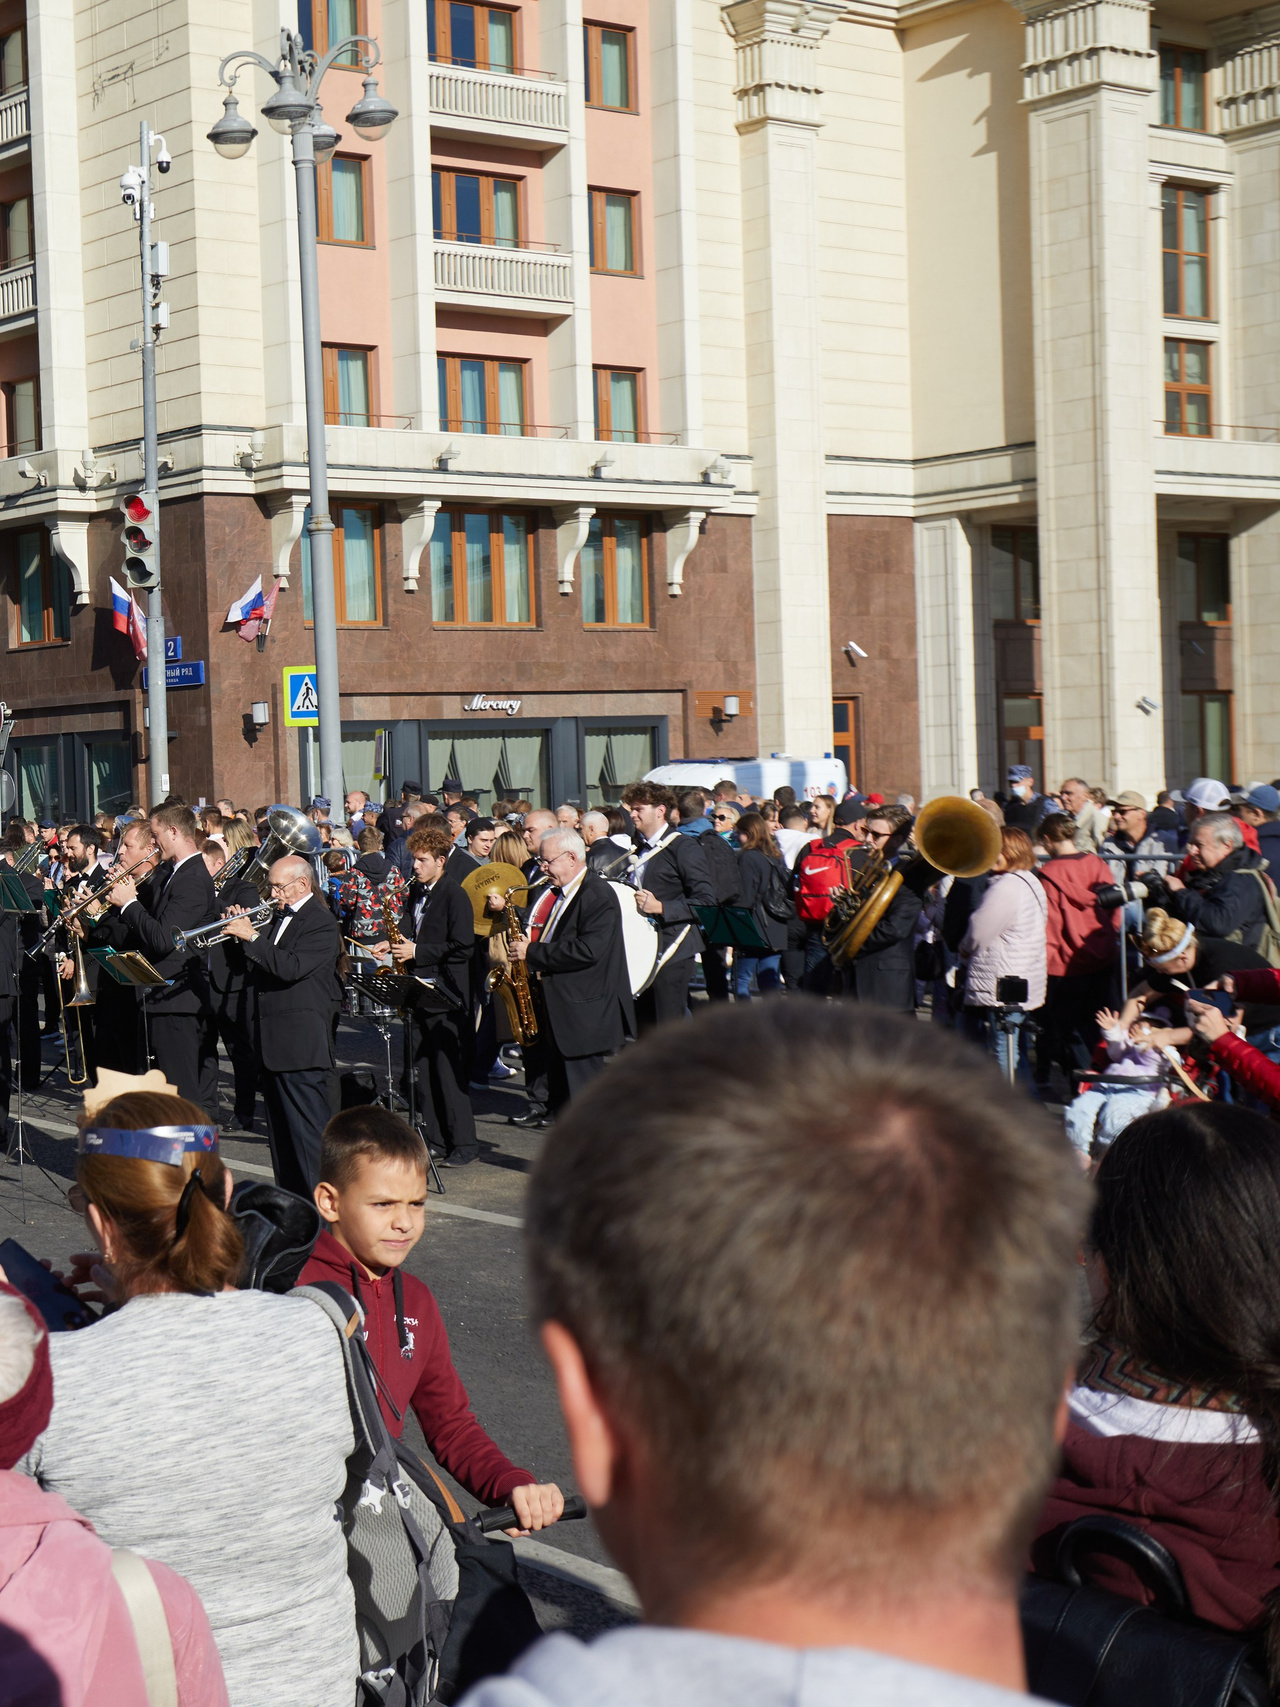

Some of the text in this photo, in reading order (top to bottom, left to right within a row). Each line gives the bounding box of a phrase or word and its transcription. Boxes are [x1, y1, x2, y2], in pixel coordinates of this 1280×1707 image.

[167, 641, 175, 656] 2
[181, 667, 193, 676] РЯД
[463, 694, 521, 715] Mercury
[474, 873, 500, 890] SABIAN
